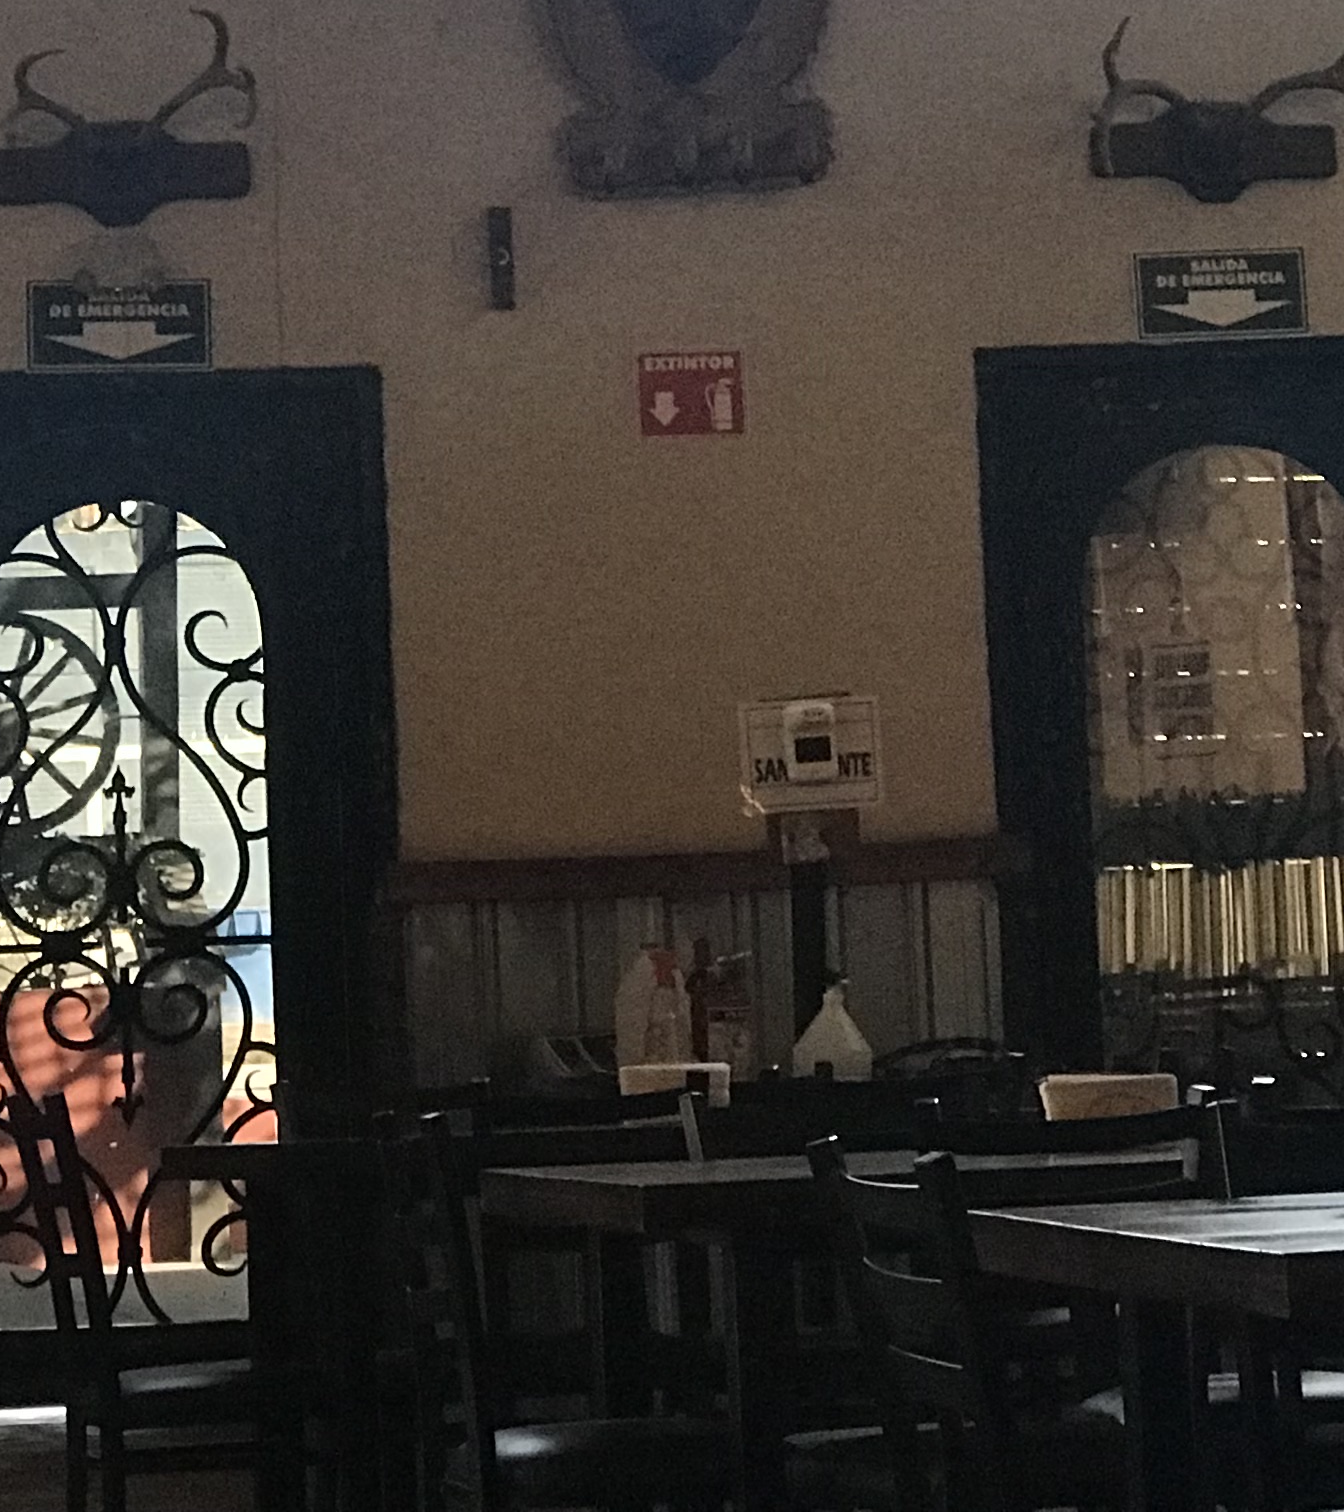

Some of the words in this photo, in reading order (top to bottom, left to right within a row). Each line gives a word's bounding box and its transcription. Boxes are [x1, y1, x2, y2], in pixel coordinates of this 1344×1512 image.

[1190, 259, 1249, 272] SALIDA
[1156, 274, 1177, 288] DE
[1182, 271, 1286, 286] EMERGENCIA
[49, 304, 72, 318] DE
[77, 303, 190, 318] EMERGENCIA
[644, 355, 735, 371] EXTINTOR
